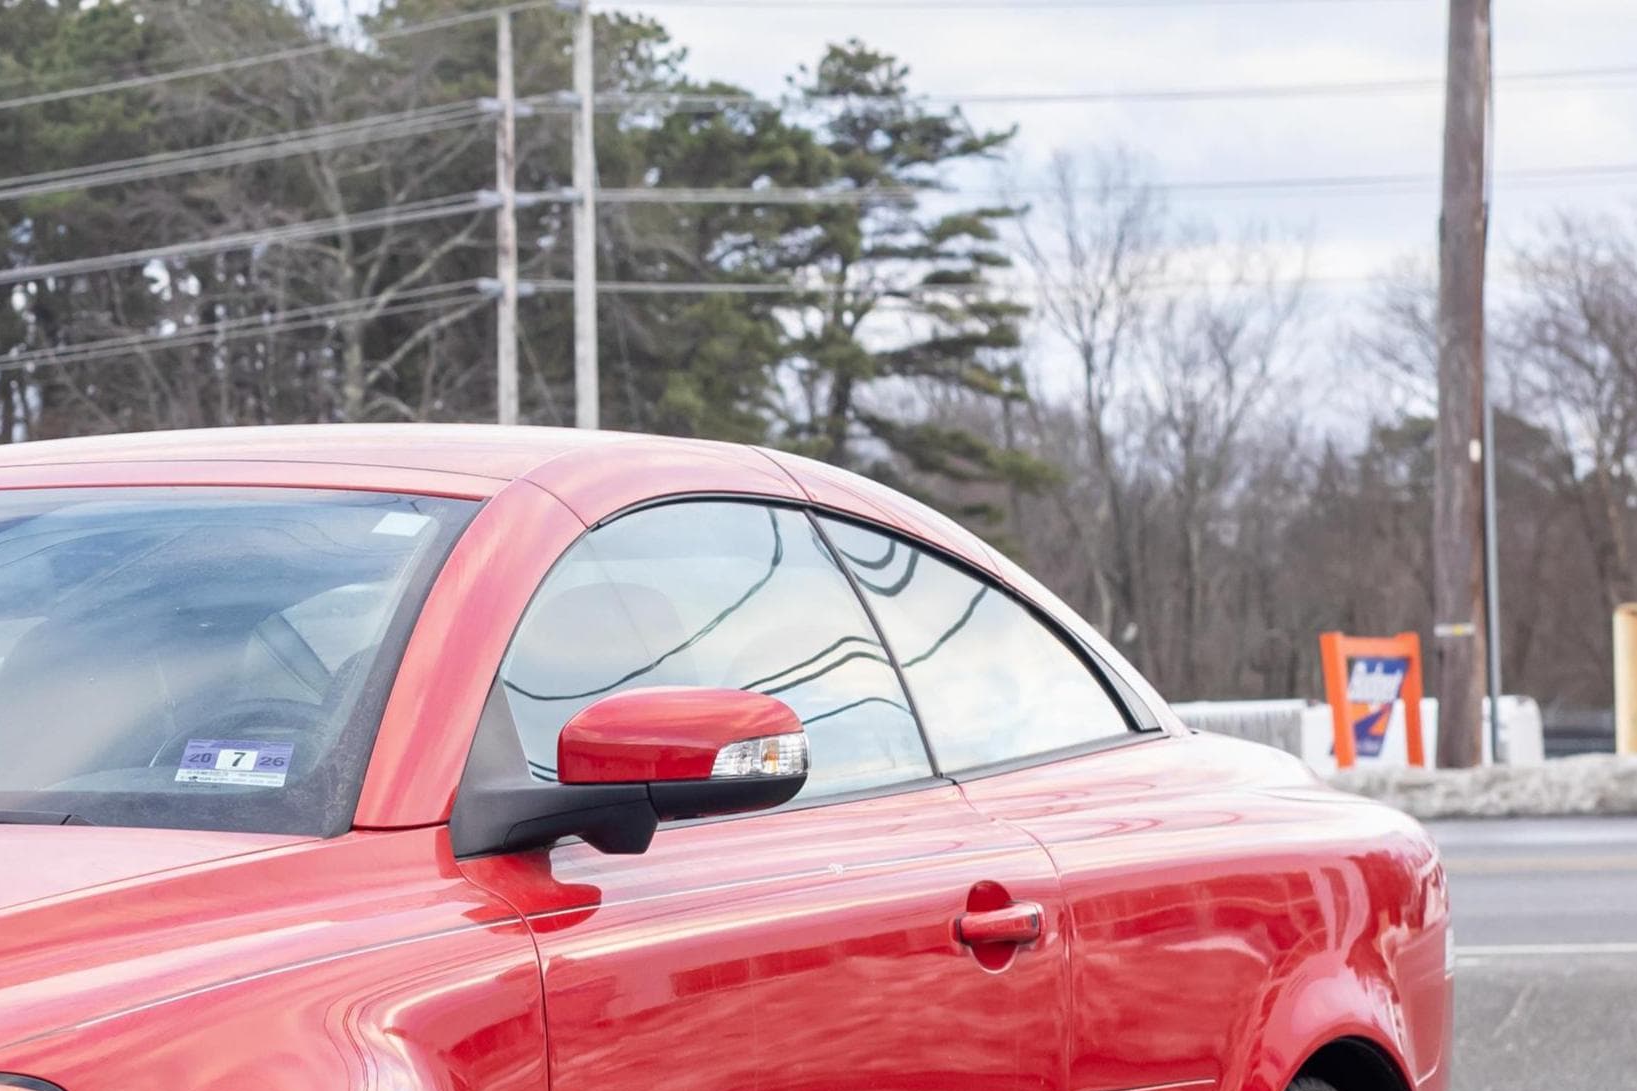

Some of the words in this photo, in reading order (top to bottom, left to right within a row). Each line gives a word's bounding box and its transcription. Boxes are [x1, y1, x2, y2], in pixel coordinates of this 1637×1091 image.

[188, 752, 213, 764] 20
[232, 751, 247, 768] 7
[259, 757, 285, 767] 26
